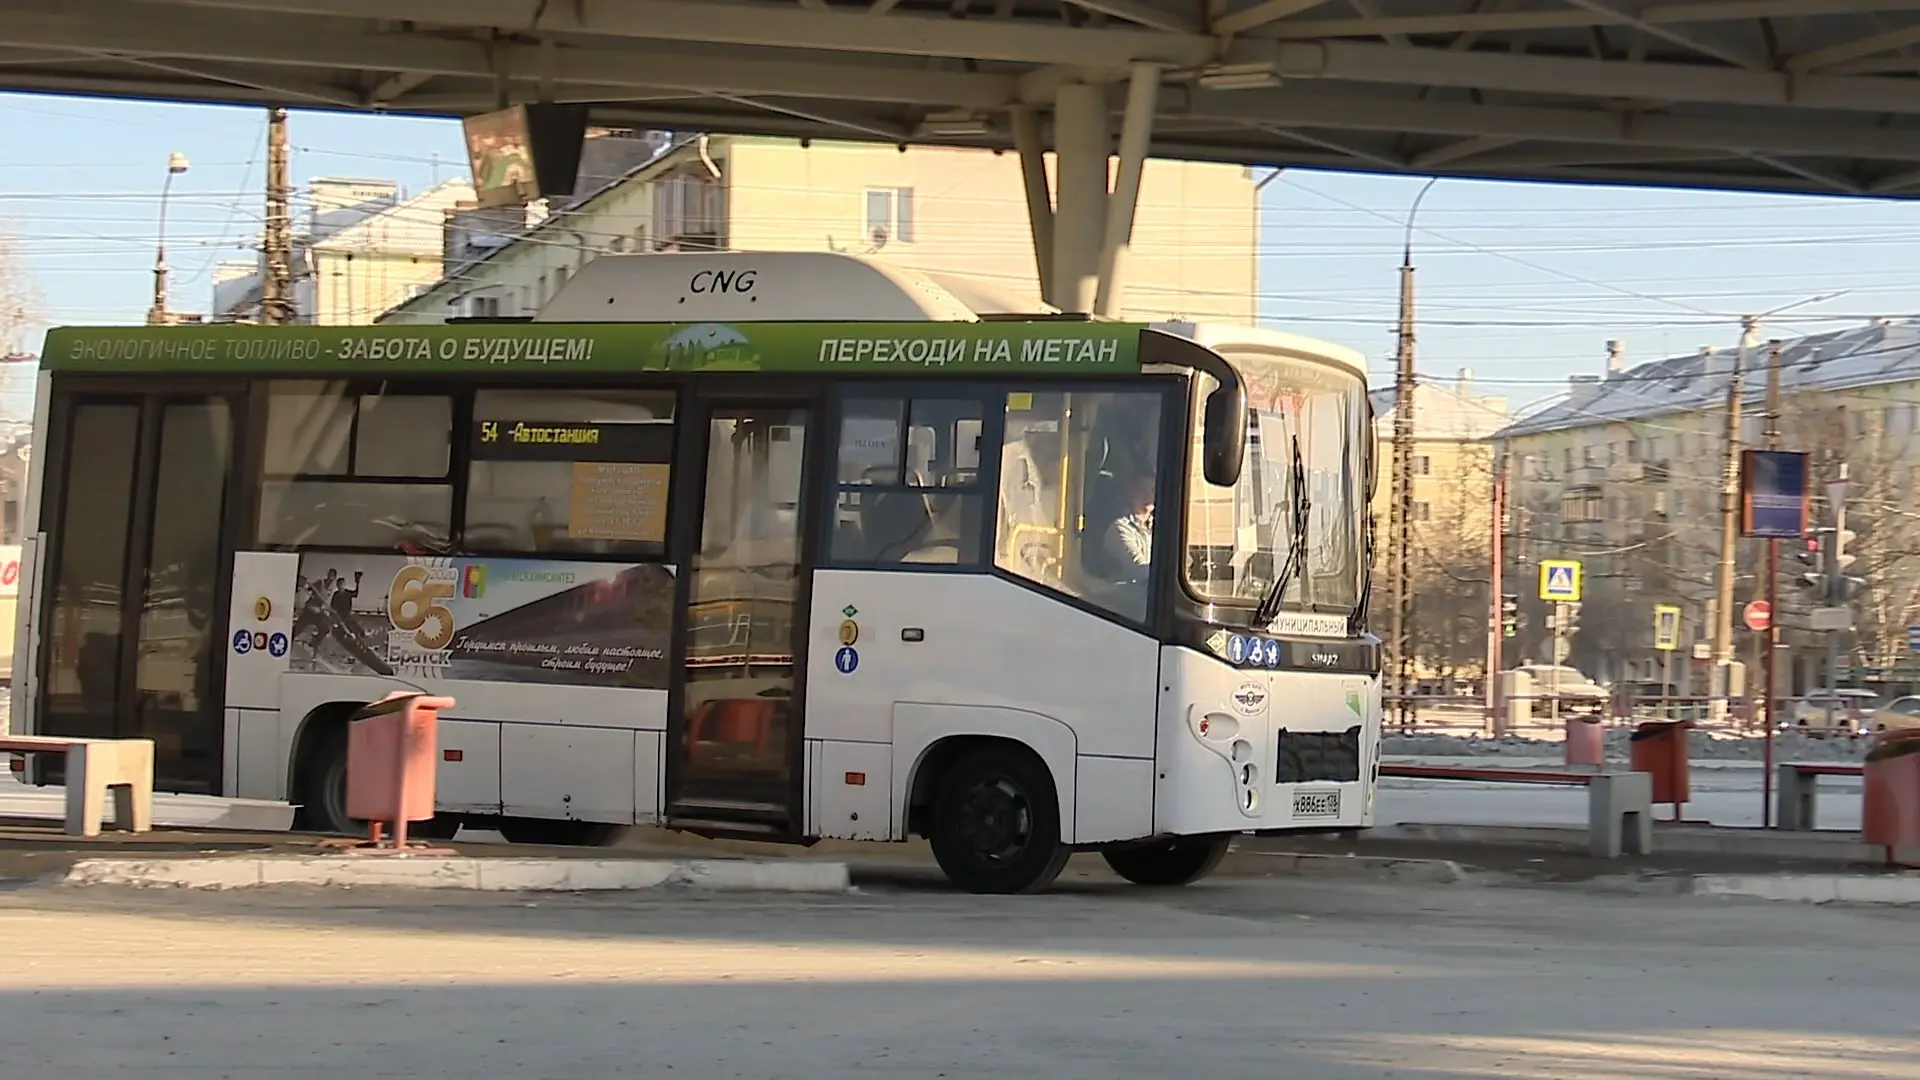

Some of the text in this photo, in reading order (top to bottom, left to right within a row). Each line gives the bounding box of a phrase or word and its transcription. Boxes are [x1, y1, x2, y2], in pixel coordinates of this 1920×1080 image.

[690, 270, 757, 293] CNG
[69, 338, 218, 361] ЭКОЛОГИЧНОЕ
[226, 338, 320, 361] ТОПЛИВО
[337, 337, 433, 361] ЗАБОТА
[438, 338, 458, 361] О
[463, 337, 595, 364] БУДУЩЕМ!
[818, 338, 1119, 366] ПЕРЕХОДИ НА МЕТАН
[481, 421, 499, 443] 54
[389, 565, 456, 650] 65
[1271, 617, 1347, 634] МУНИЦИПАЛЬНЫЙ
[389, 646, 450, 667] Братск
[456, 635, 664, 660] Гордимся прошлым, любим настоящее,
[541, 658, 635, 674] строим будущее!
